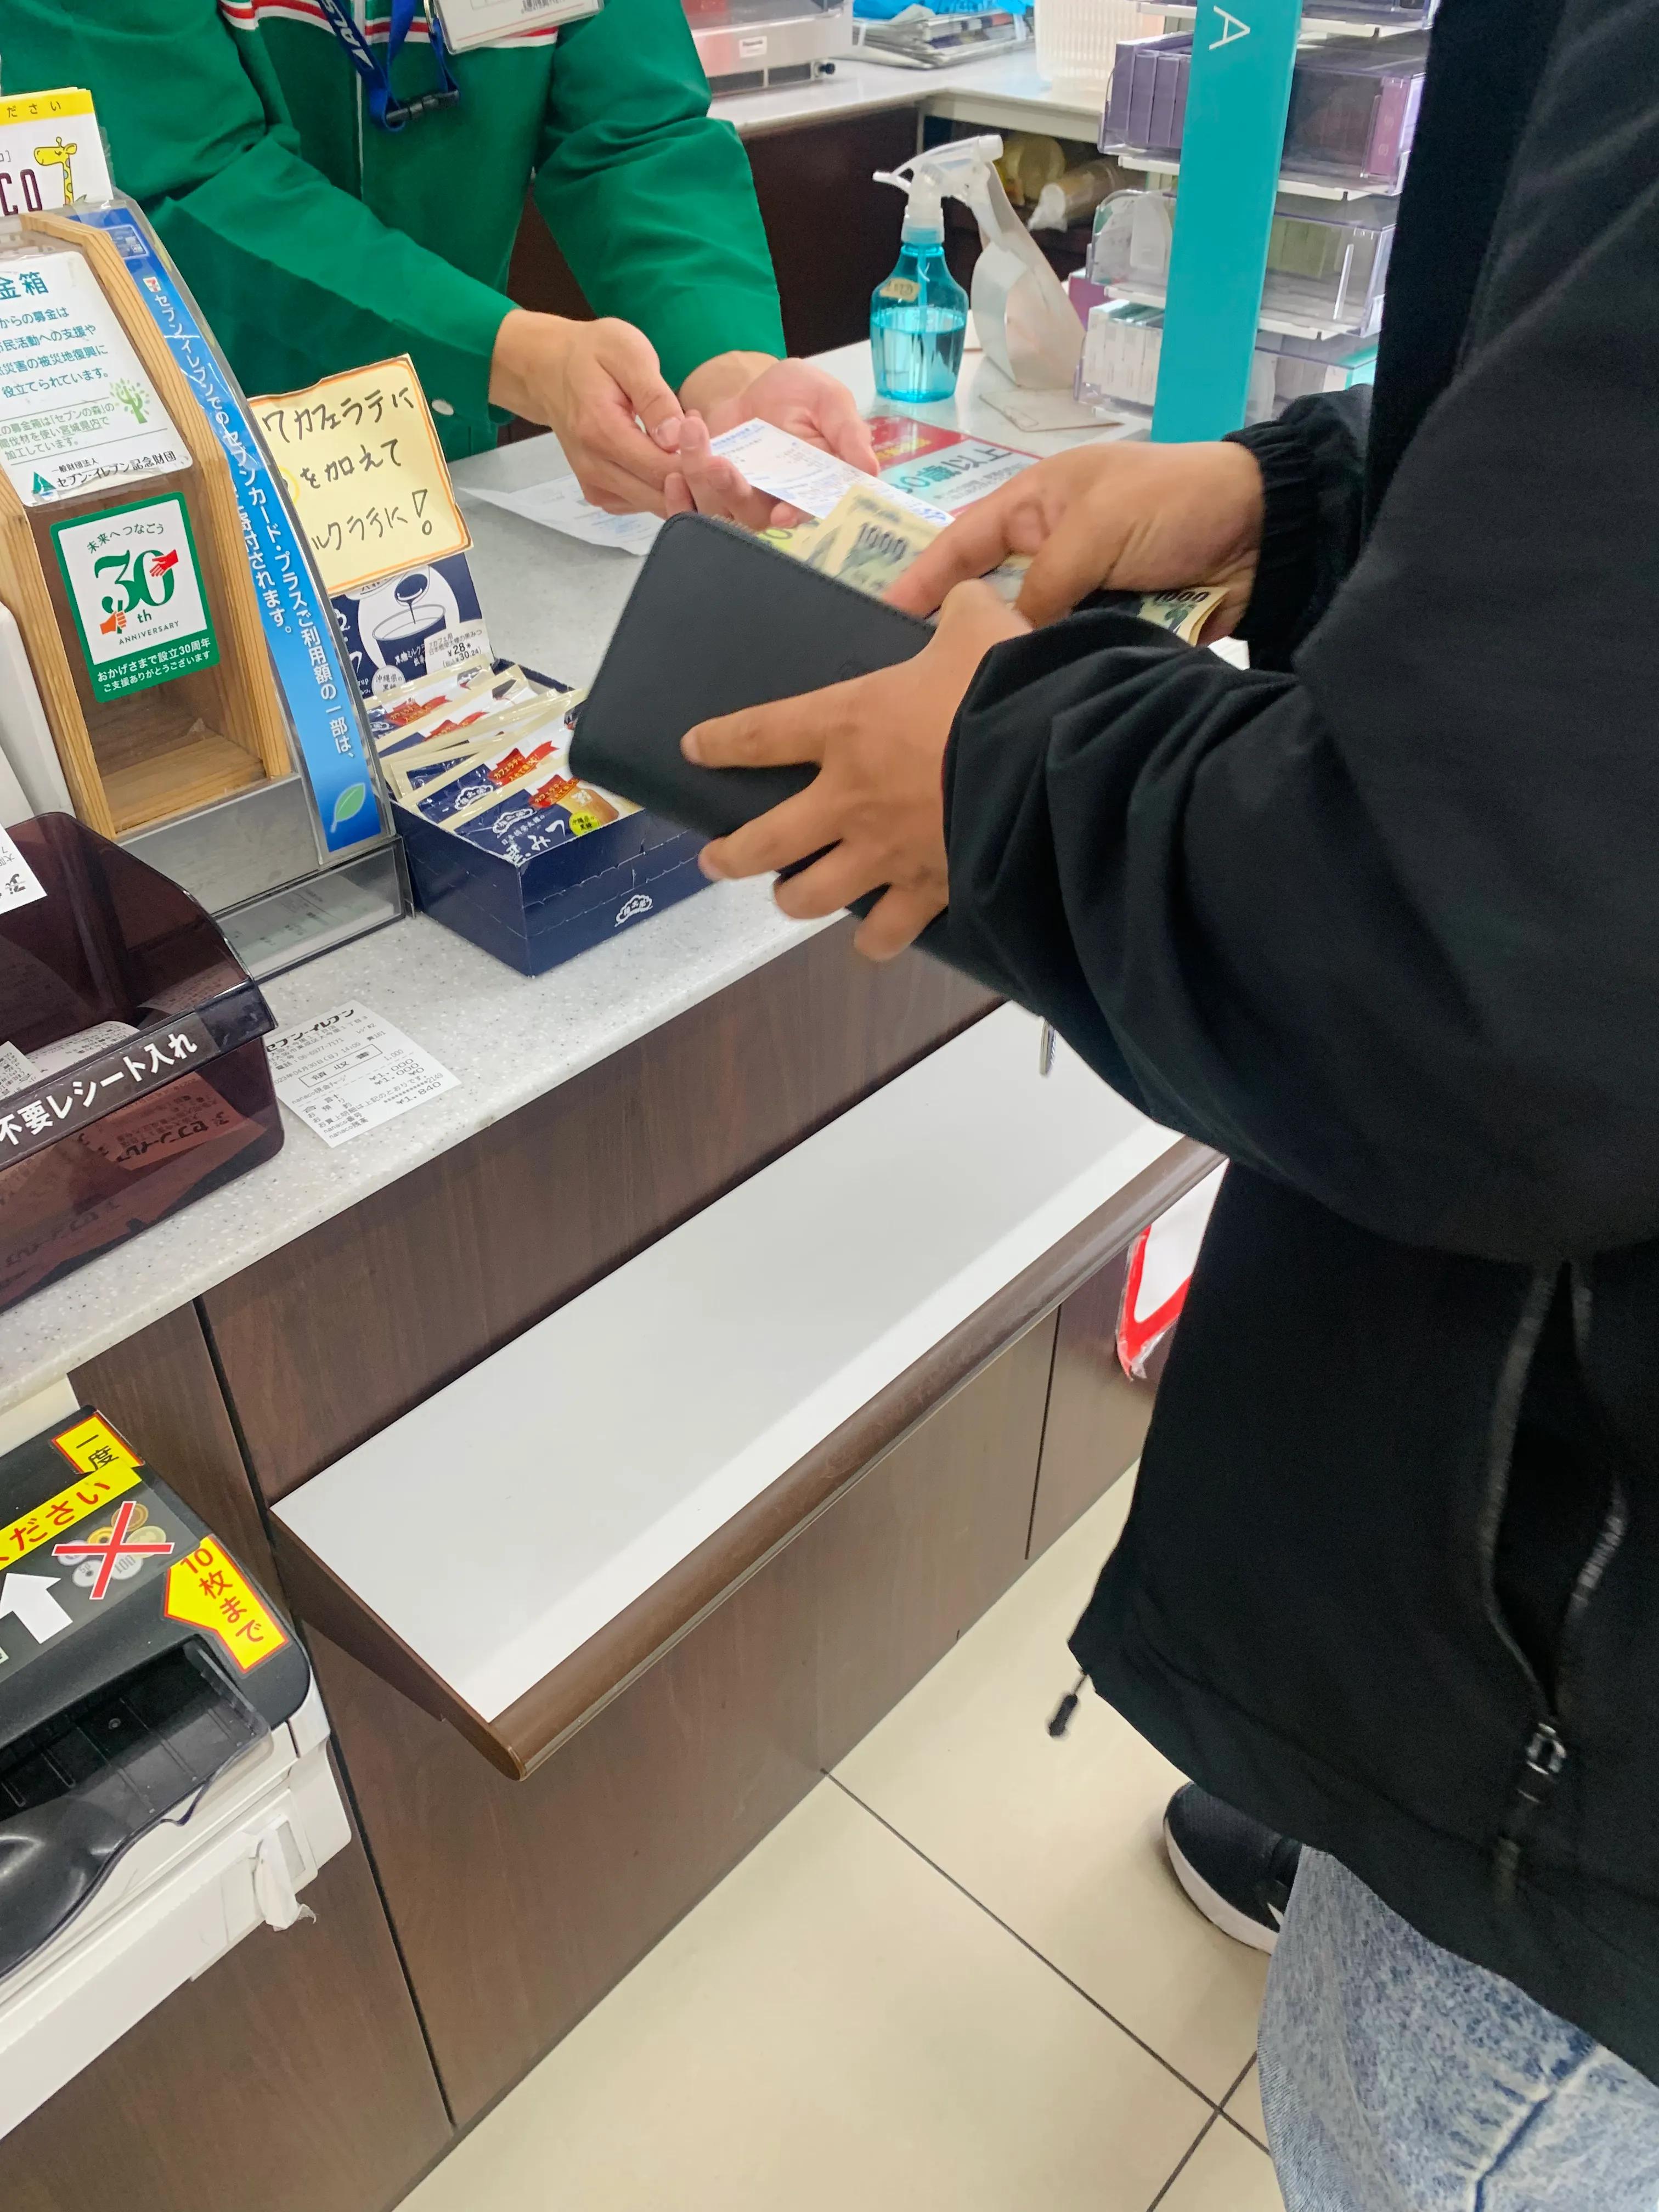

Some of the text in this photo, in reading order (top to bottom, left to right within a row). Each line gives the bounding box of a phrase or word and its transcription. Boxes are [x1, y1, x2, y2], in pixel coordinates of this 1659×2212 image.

[1209, 5, 1251, 50] A
[7, 101, 61, 118] ださい
[2, 367, 109, 398] 役立てられています。
[52, 457, 99, 473] 一般財団法人
[300, 438, 402, 489] を加えて
[86, 523, 164, 554] 未来へつなごう
[94, 549, 175, 614] 30
[119, 620, 180, 645] ANNIVERSARY
[137, 609, 152, 623] th
[97, 636, 211, 682] おかげさまで設立30周年
[103, 650, 211, 692] ご支援ありがとうございます
[0, 1031, 198, 1146] 不要レシート入れ
[0, 1482, 111, 1562] ださい
[180, 1547, 264, 1643] 10枚まで
